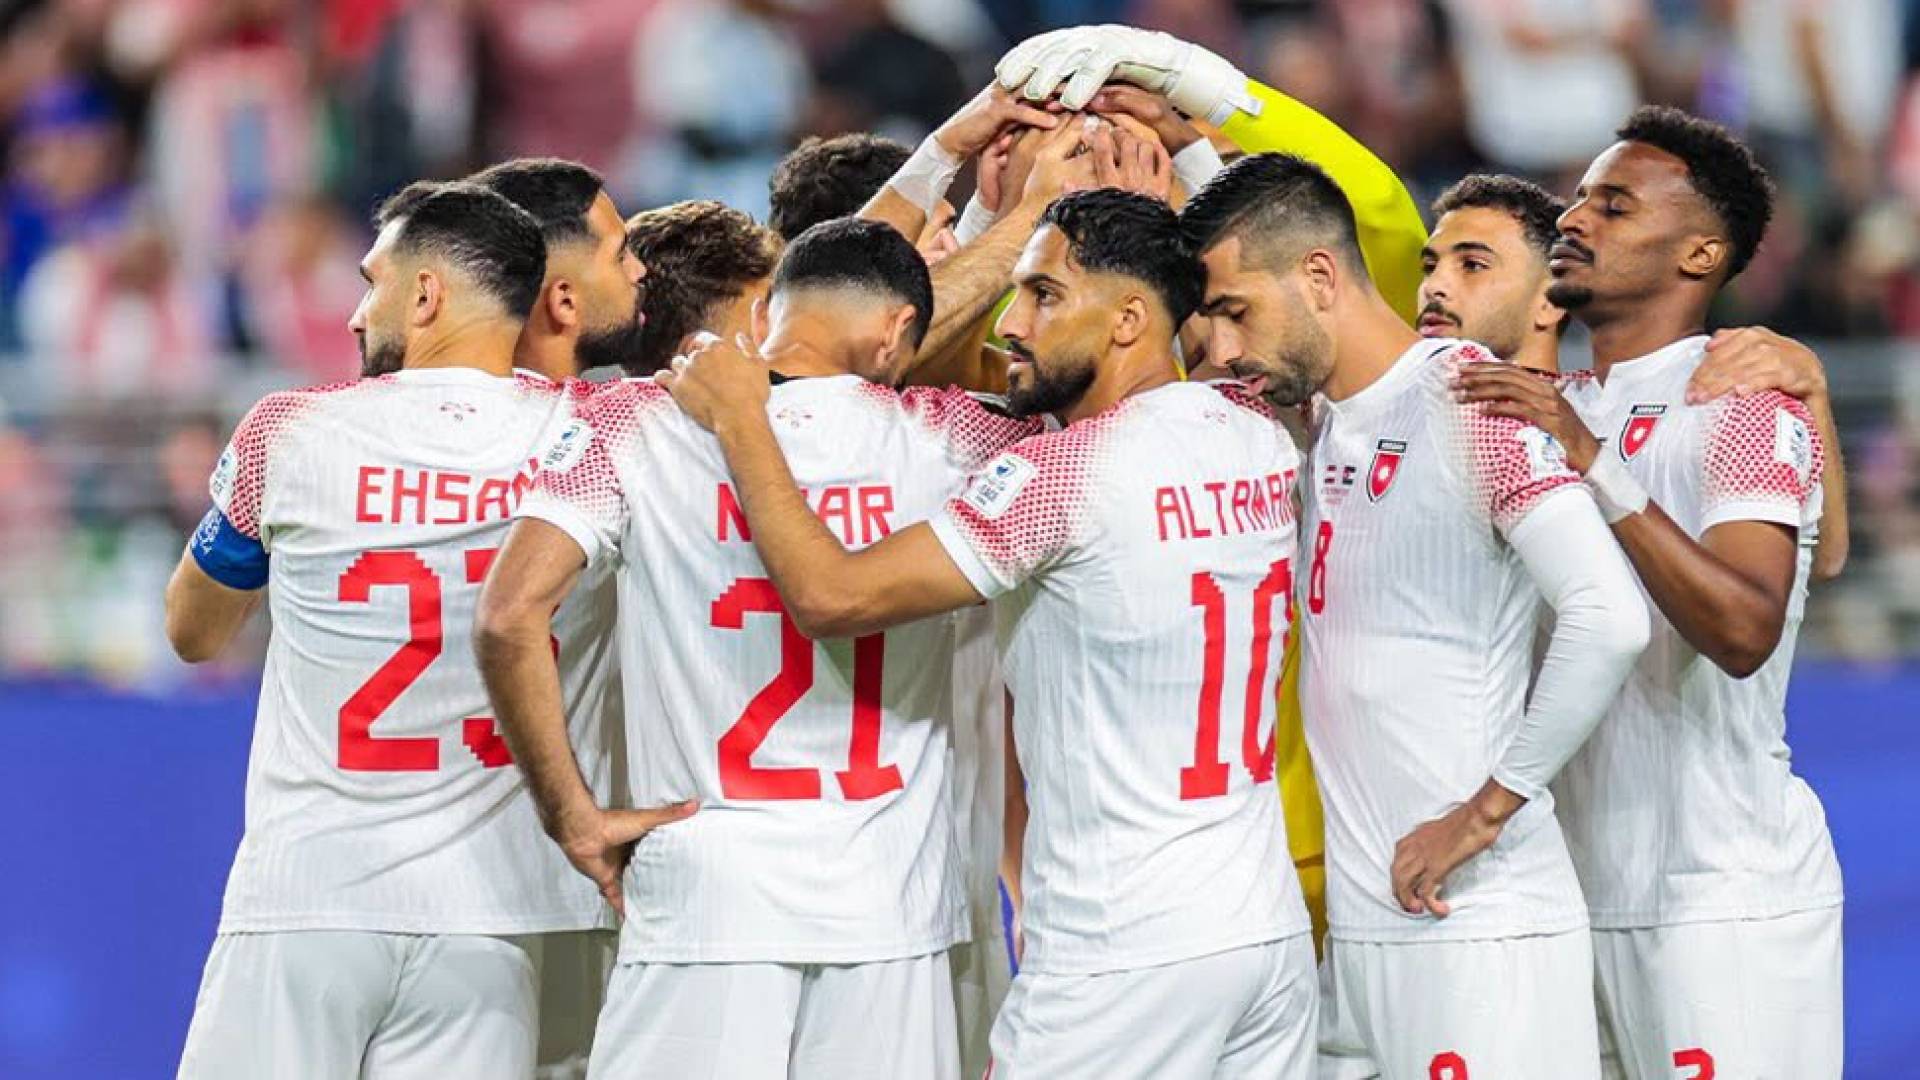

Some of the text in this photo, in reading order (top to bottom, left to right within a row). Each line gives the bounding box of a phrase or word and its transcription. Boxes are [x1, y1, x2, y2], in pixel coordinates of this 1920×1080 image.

[338, 550, 559, 771] 2
[1309, 520, 1333, 615] 8
[710, 577, 904, 801] 21
[1180, 558, 1294, 800] 10
